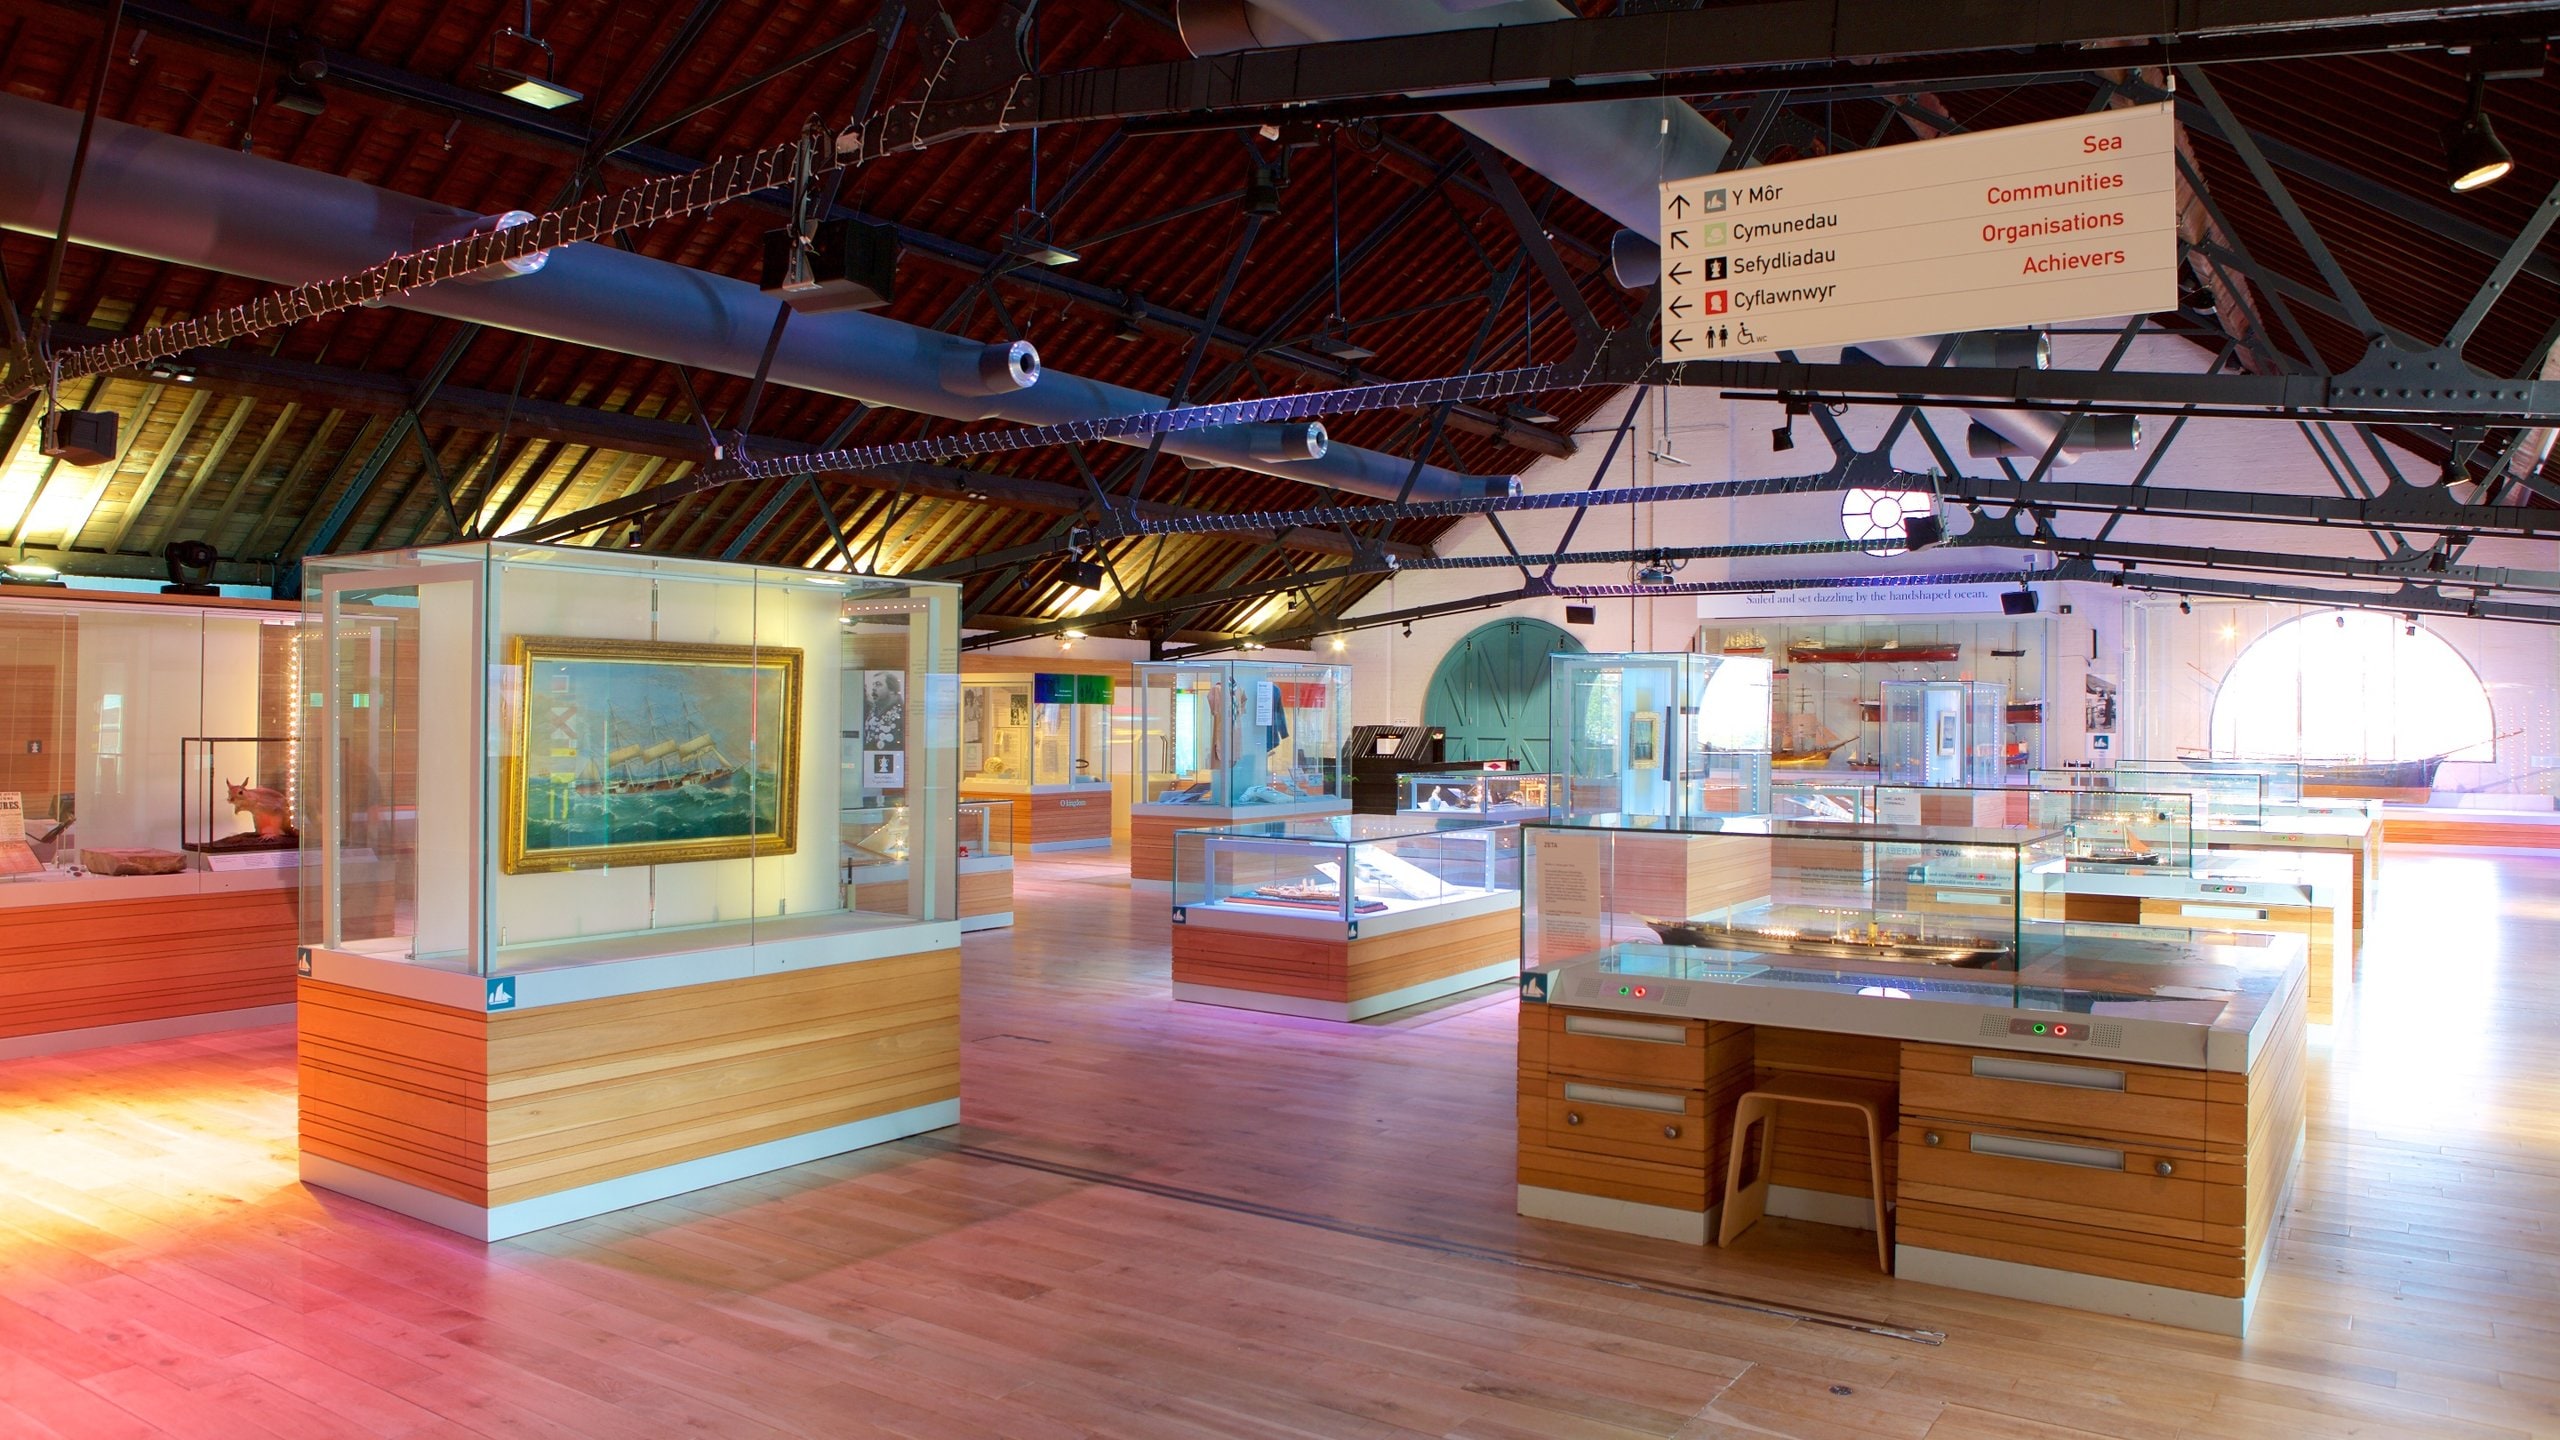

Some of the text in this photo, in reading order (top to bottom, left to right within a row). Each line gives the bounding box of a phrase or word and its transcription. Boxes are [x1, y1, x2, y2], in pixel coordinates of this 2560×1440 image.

[2083, 135, 2123, 154] Sea
[1732, 184, 1784, 206] Y Môr
[1987, 173, 2124, 205] Communities
[1733, 213, 1838, 243] Cymunedau
[1982, 212, 2125, 244] Organisations
[1733, 248, 1836, 275] Sefydliadau
[2022, 250, 2125, 275] Achievers
[1734, 284, 1837, 311] Cyflawnwyr
[1756, 335, 1768, 343] WC
[1746, 589, 1989, 604] Sailed and set dazzling by the handshaped ocean.
